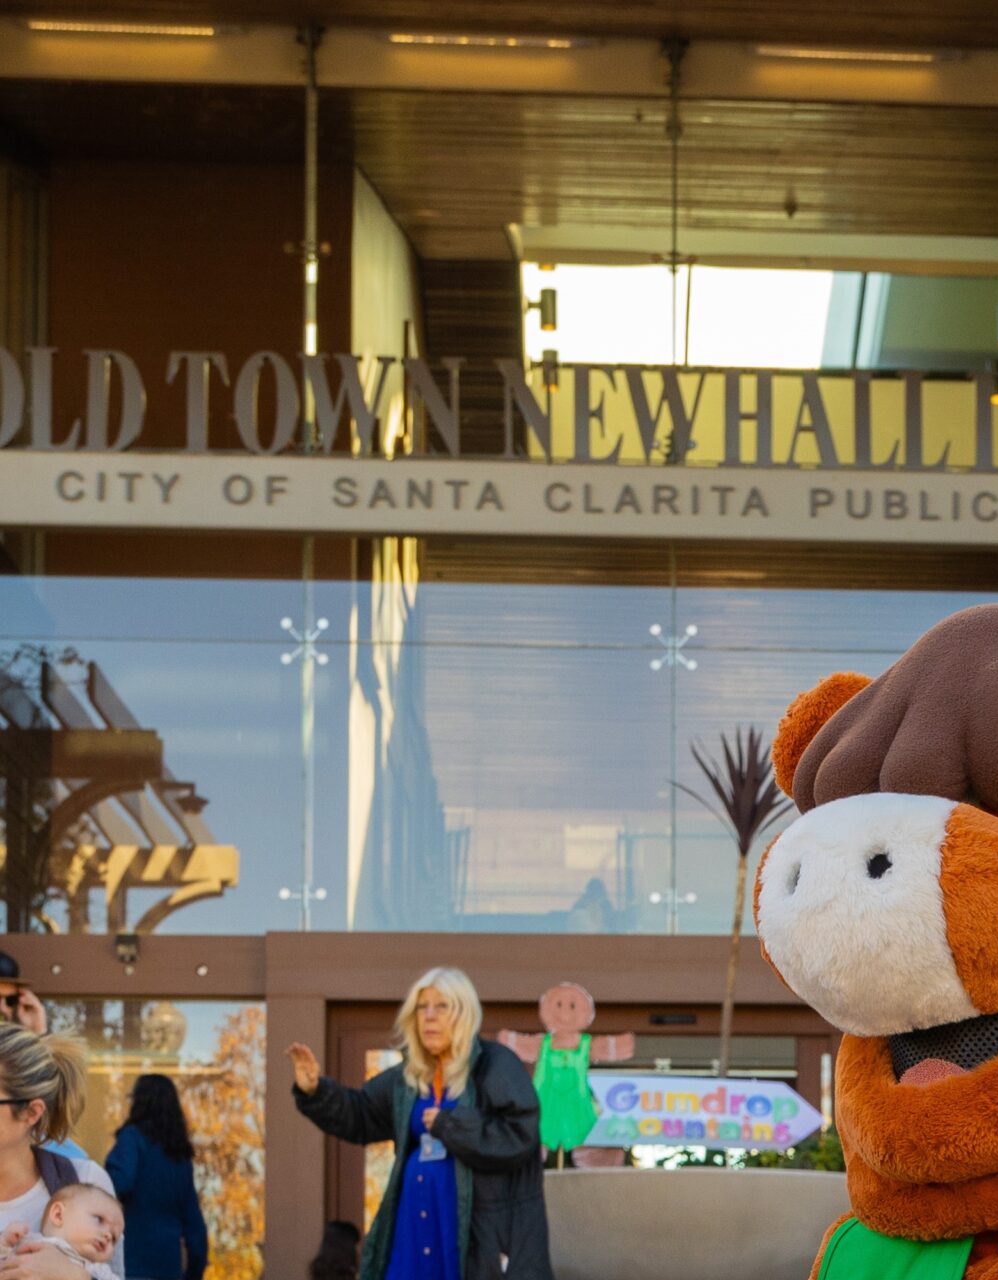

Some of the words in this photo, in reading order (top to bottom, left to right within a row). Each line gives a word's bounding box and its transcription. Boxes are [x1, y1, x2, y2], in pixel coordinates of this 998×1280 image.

[165, 350, 467, 459] TOWN
[496, 358, 951, 467] NEWHALL
[56, 470, 180, 503] CITY
[222, 474, 291, 505] OF
[332, 476, 504, 511] SANTA
[543, 481, 770, 517] CLARITA
[606, 1082, 798, 1122] Gumdrop
